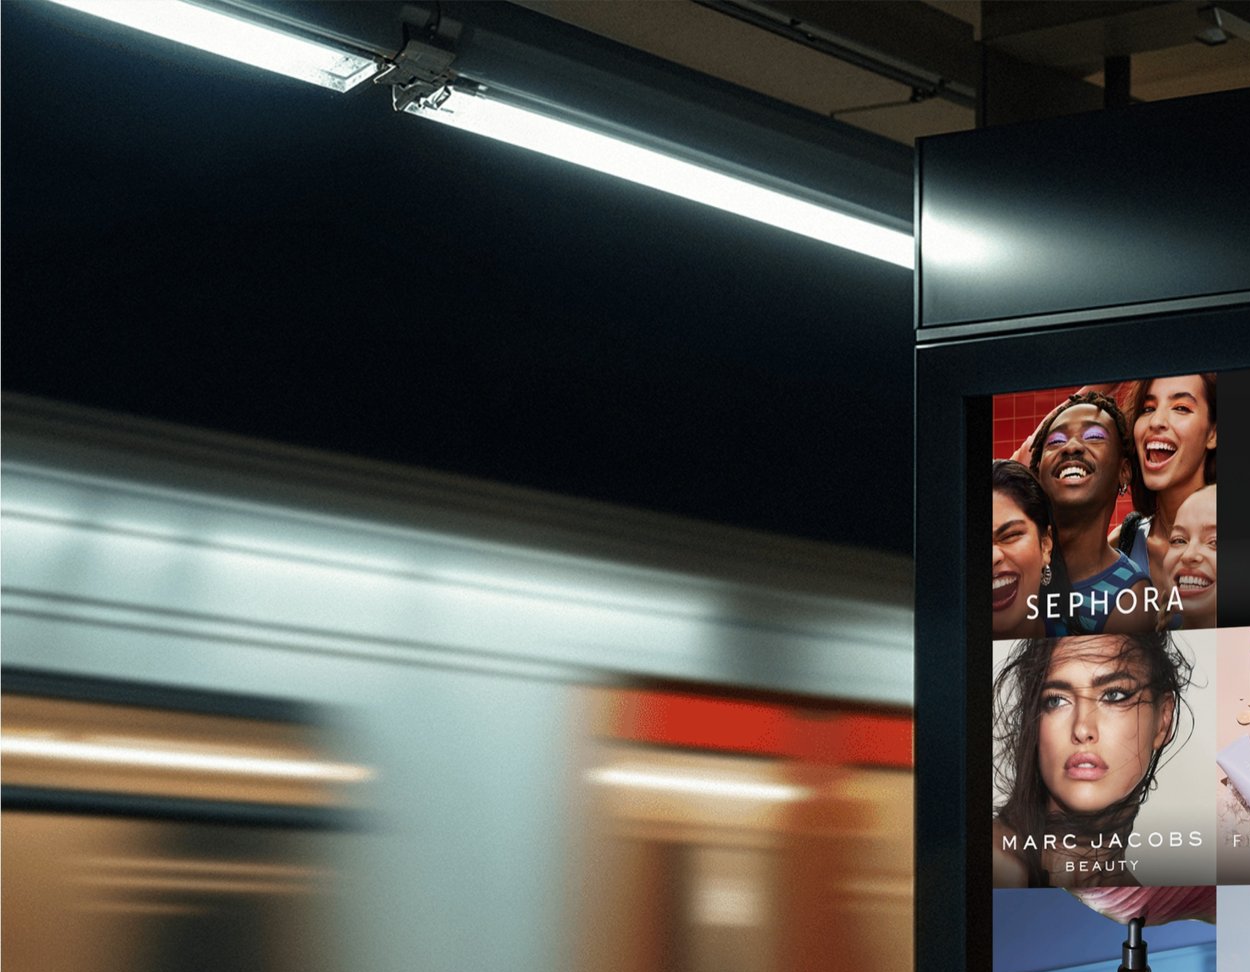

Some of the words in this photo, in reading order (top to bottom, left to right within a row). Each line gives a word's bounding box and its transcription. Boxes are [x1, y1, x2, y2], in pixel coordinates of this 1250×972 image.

[1026, 585, 1184, 620] SEPHORA
[1002, 833, 1077, 851] MARC
[1090, 830, 1204, 849] JACOBS
[1065, 860, 1139, 873] BEAUTY
